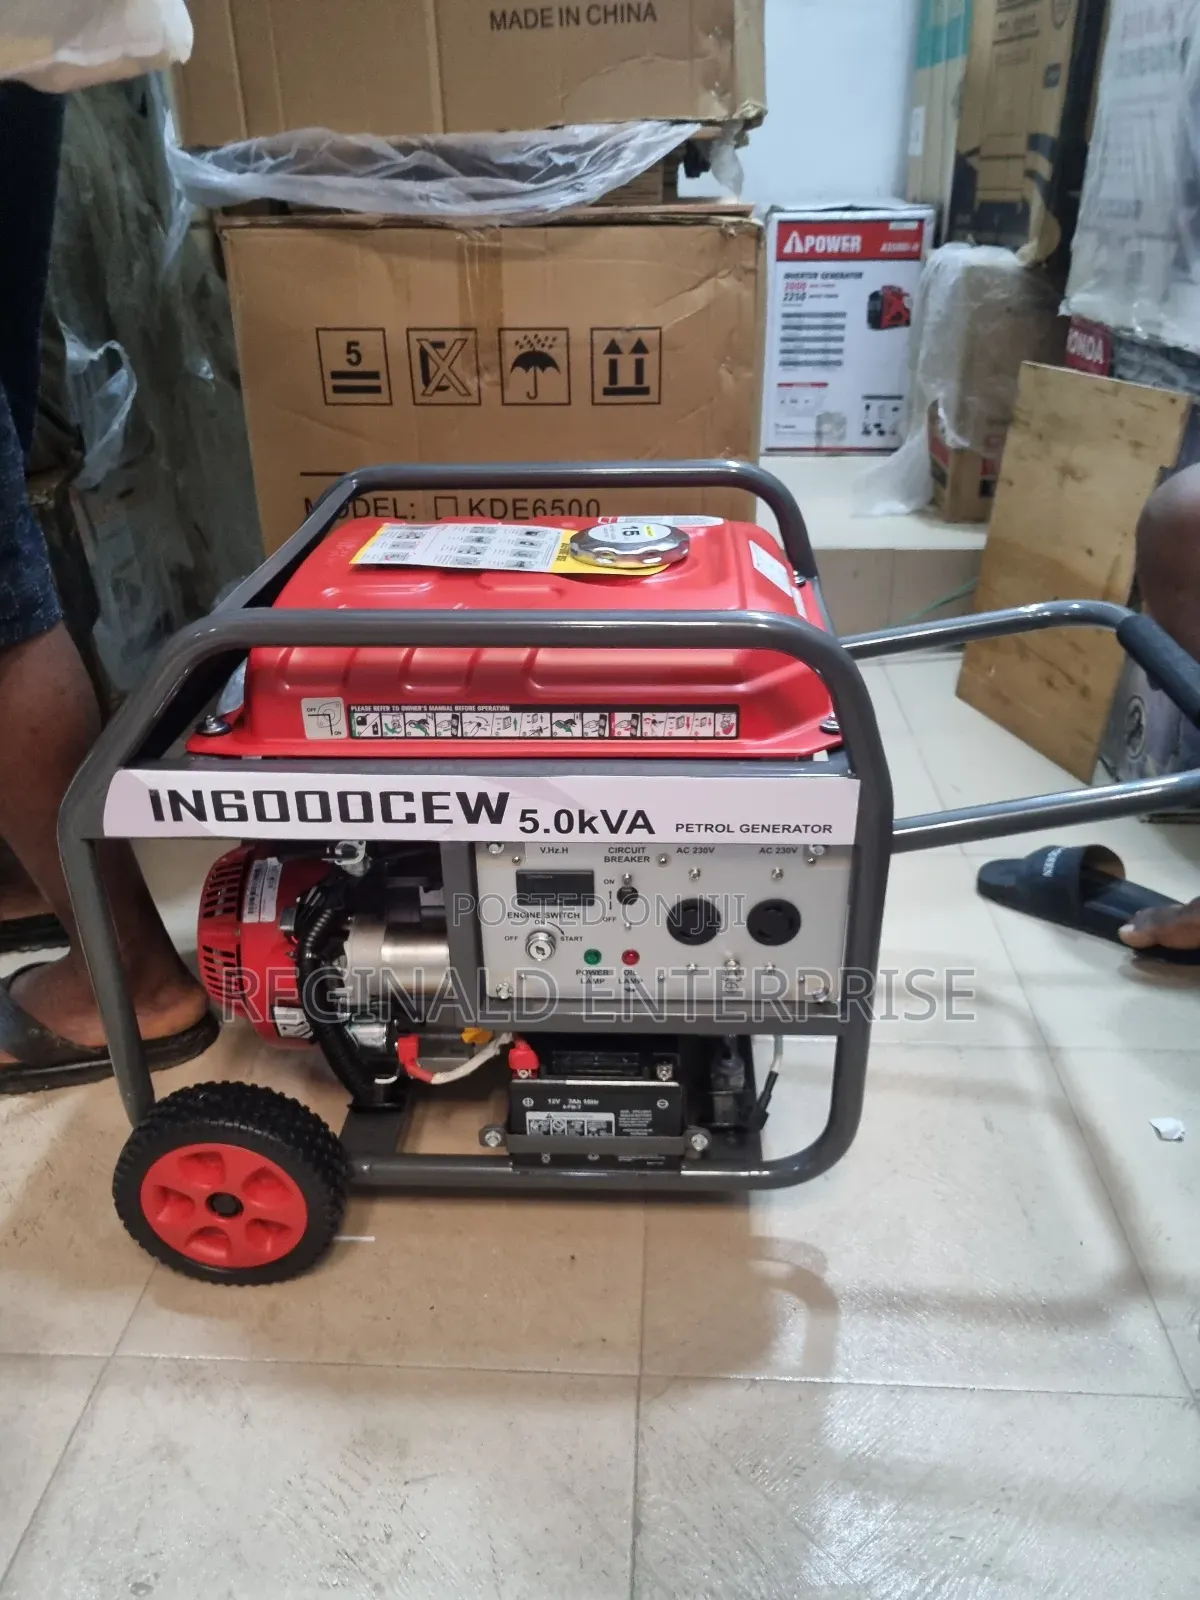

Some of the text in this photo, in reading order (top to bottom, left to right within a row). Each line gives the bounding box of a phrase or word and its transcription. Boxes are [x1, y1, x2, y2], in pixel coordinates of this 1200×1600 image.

[489, 2, 658, 31] MADE IN CHINA
[1065, 327, 1105, 364] ONDA
[345, 340, 362, 367] 5
[468, 498, 600, 520] KDE6500
[148, 788, 833, 835] IN6000CEW 5.0kVA PETROL GENERATOR
[539, 846, 569, 854] V.Hz.H
[608, 846, 646, 855] CIRCUIT
[676, 846, 715, 854] AC 230V
[759, 846, 798, 855] AC 230V
[603, 855, 650, 864] BREAKER
[507, 911, 580, 919] ENGINE SWITCH
